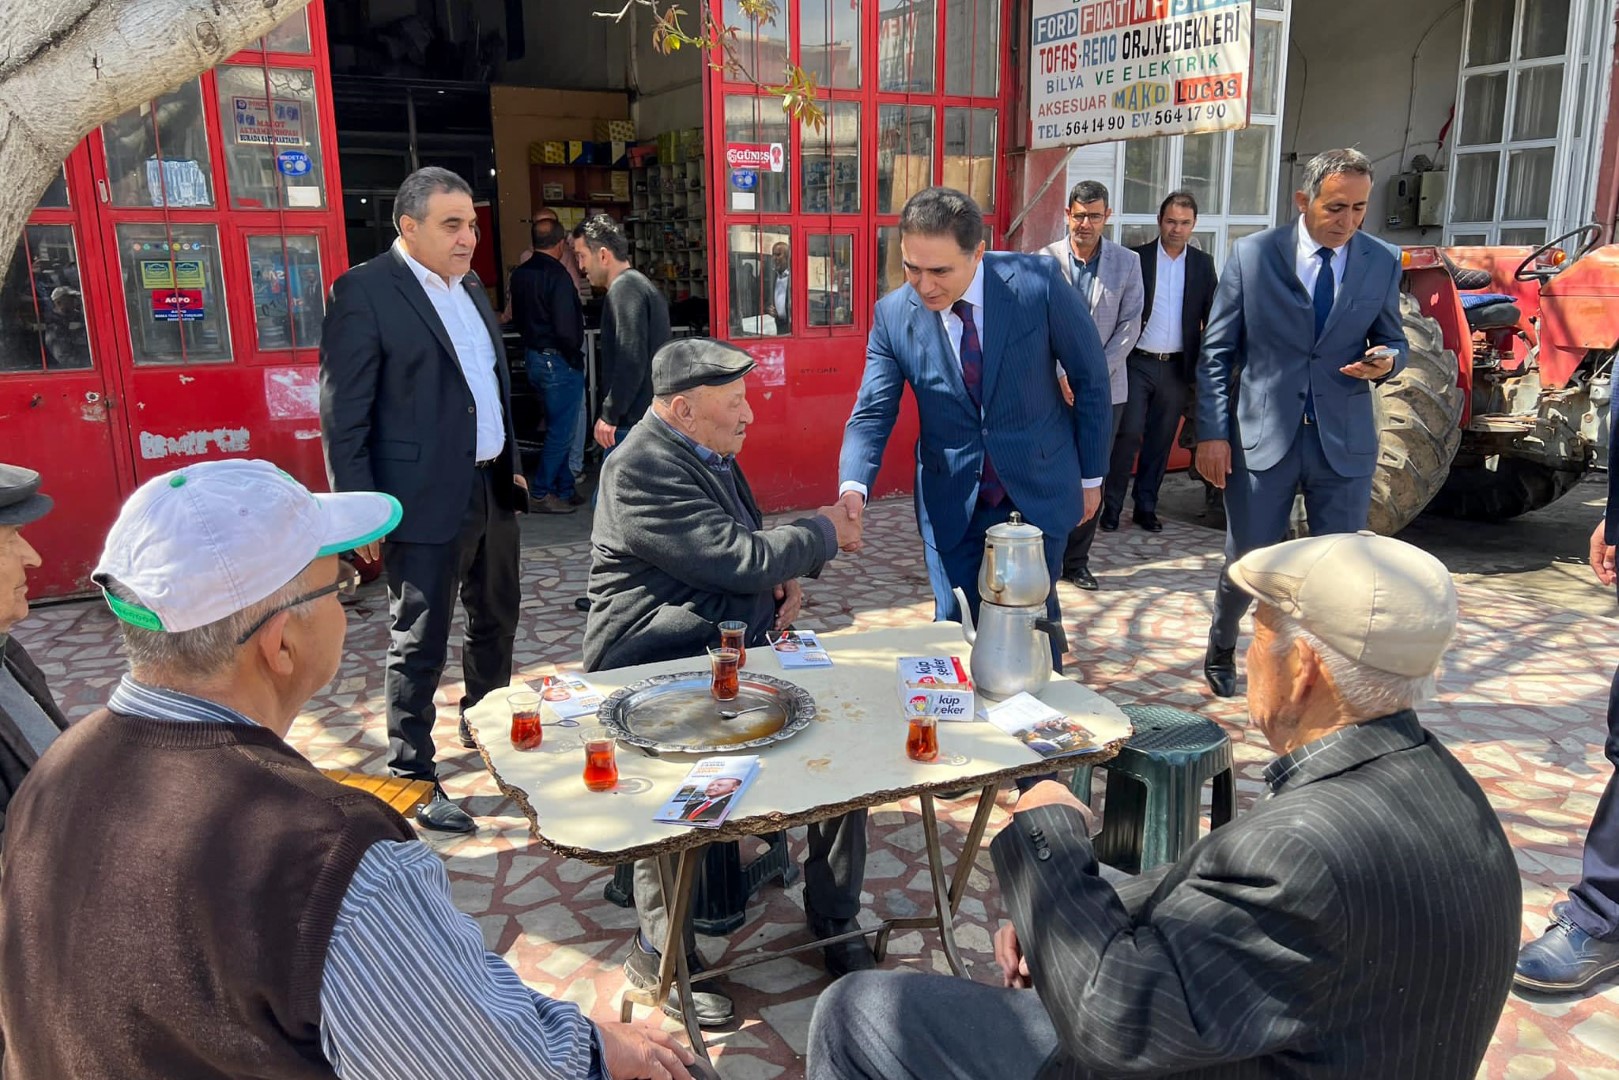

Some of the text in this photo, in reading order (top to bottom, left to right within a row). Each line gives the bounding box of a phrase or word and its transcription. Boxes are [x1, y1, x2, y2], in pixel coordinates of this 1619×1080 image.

[1037, 11, 1077, 42] FORD
[1083, 1, 1128, 31] FIAT
[1046, 74, 1084, 95] BİLYA
[1095, 70, 1114, 86] VE
[1038, 94, 1107, 119] AKSESUAR
[1177, 79, 1239, 103] Lucas
[916, 661, 931, 674] küp
[936, 705, 965, 714] eker
[938, 694, 960, 706] küp
